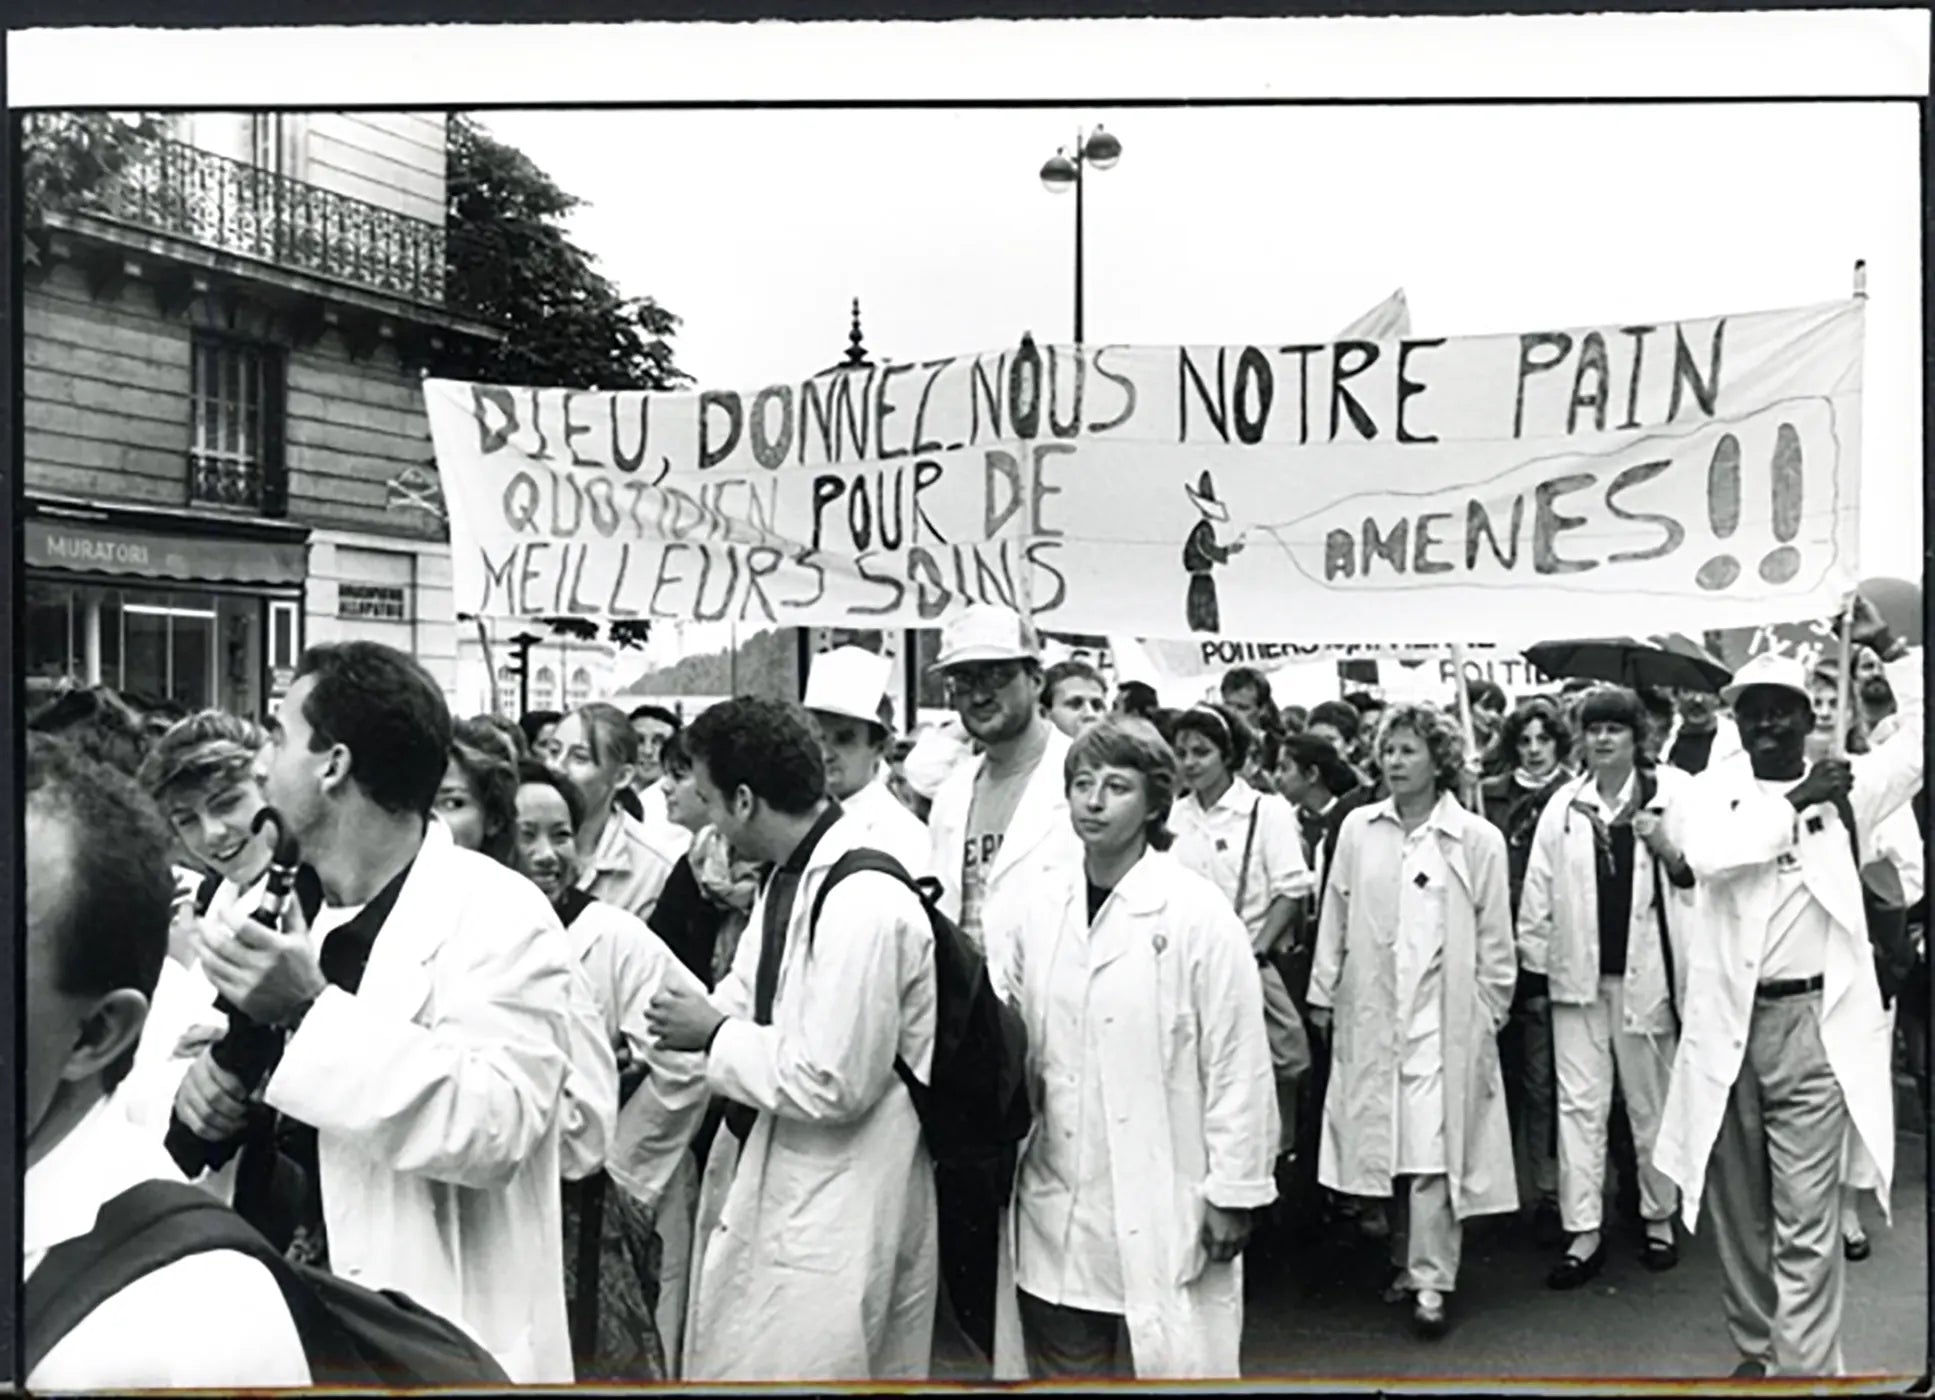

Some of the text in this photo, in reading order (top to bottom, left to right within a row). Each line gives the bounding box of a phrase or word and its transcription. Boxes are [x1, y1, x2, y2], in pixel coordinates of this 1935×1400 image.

[471, 385, 669, 486] DIEU,
[1179, 338, 1447, 445] NOTRE
[1513, 318, 1726, 438] PAIN
[503, 443, 1077, 551] QUOTIDIEN POUR DE
[47, 535, 149, 565] MURATORI
[480, 540, 1065, 622] MEILLEURS SOINS
